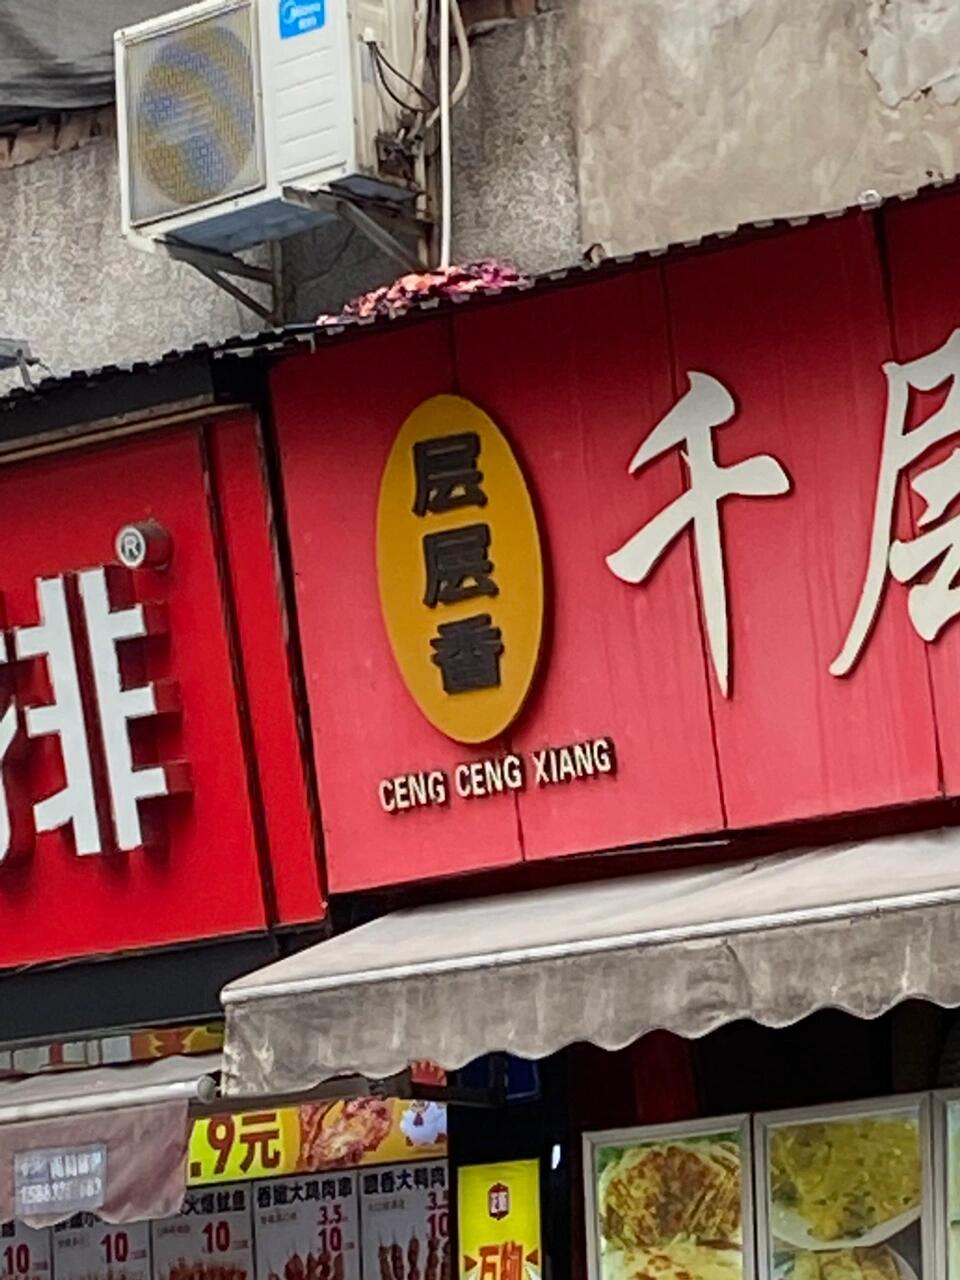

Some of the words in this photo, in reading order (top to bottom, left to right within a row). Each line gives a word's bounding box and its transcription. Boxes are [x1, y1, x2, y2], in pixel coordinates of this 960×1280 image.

[411, 431, 504, 695] 层层香
[378, 777, 445, 813] CENG
[455, 757, 522, 799] CENG
[534, 738, 612, 782] XIANG
[188, 1107, 281, 1178] .9元
[102, 1231, 129, 1264] 10
[203, 1220, 231, 1254] 10
[318, 1226, 342, 1253] 10
[4, 1243, 31, 1275] 10
